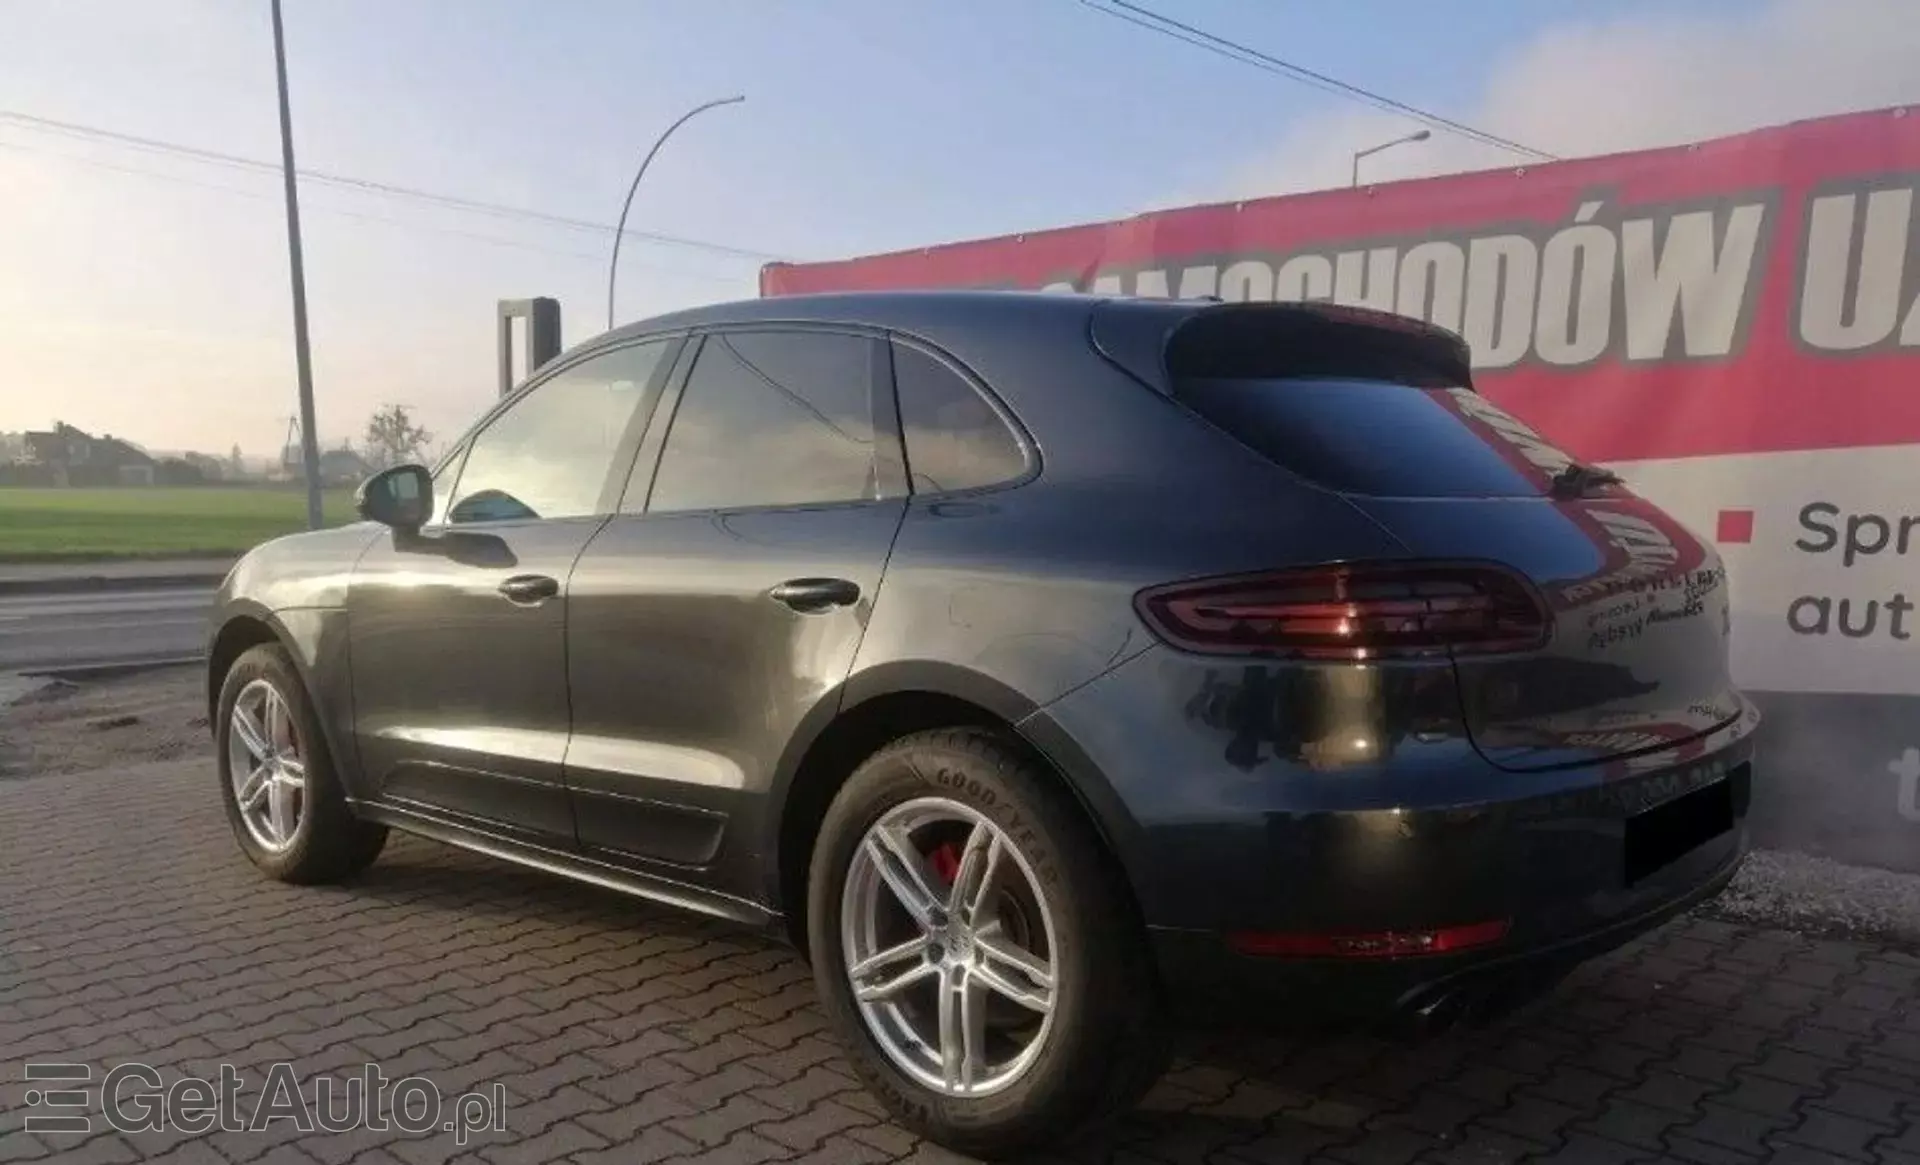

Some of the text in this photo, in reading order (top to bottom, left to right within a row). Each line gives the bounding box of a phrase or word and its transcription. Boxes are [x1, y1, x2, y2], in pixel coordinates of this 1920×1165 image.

[1044, 187, 1920, 370] HODÓW U
[1787, 593, 1914, 640] aut
